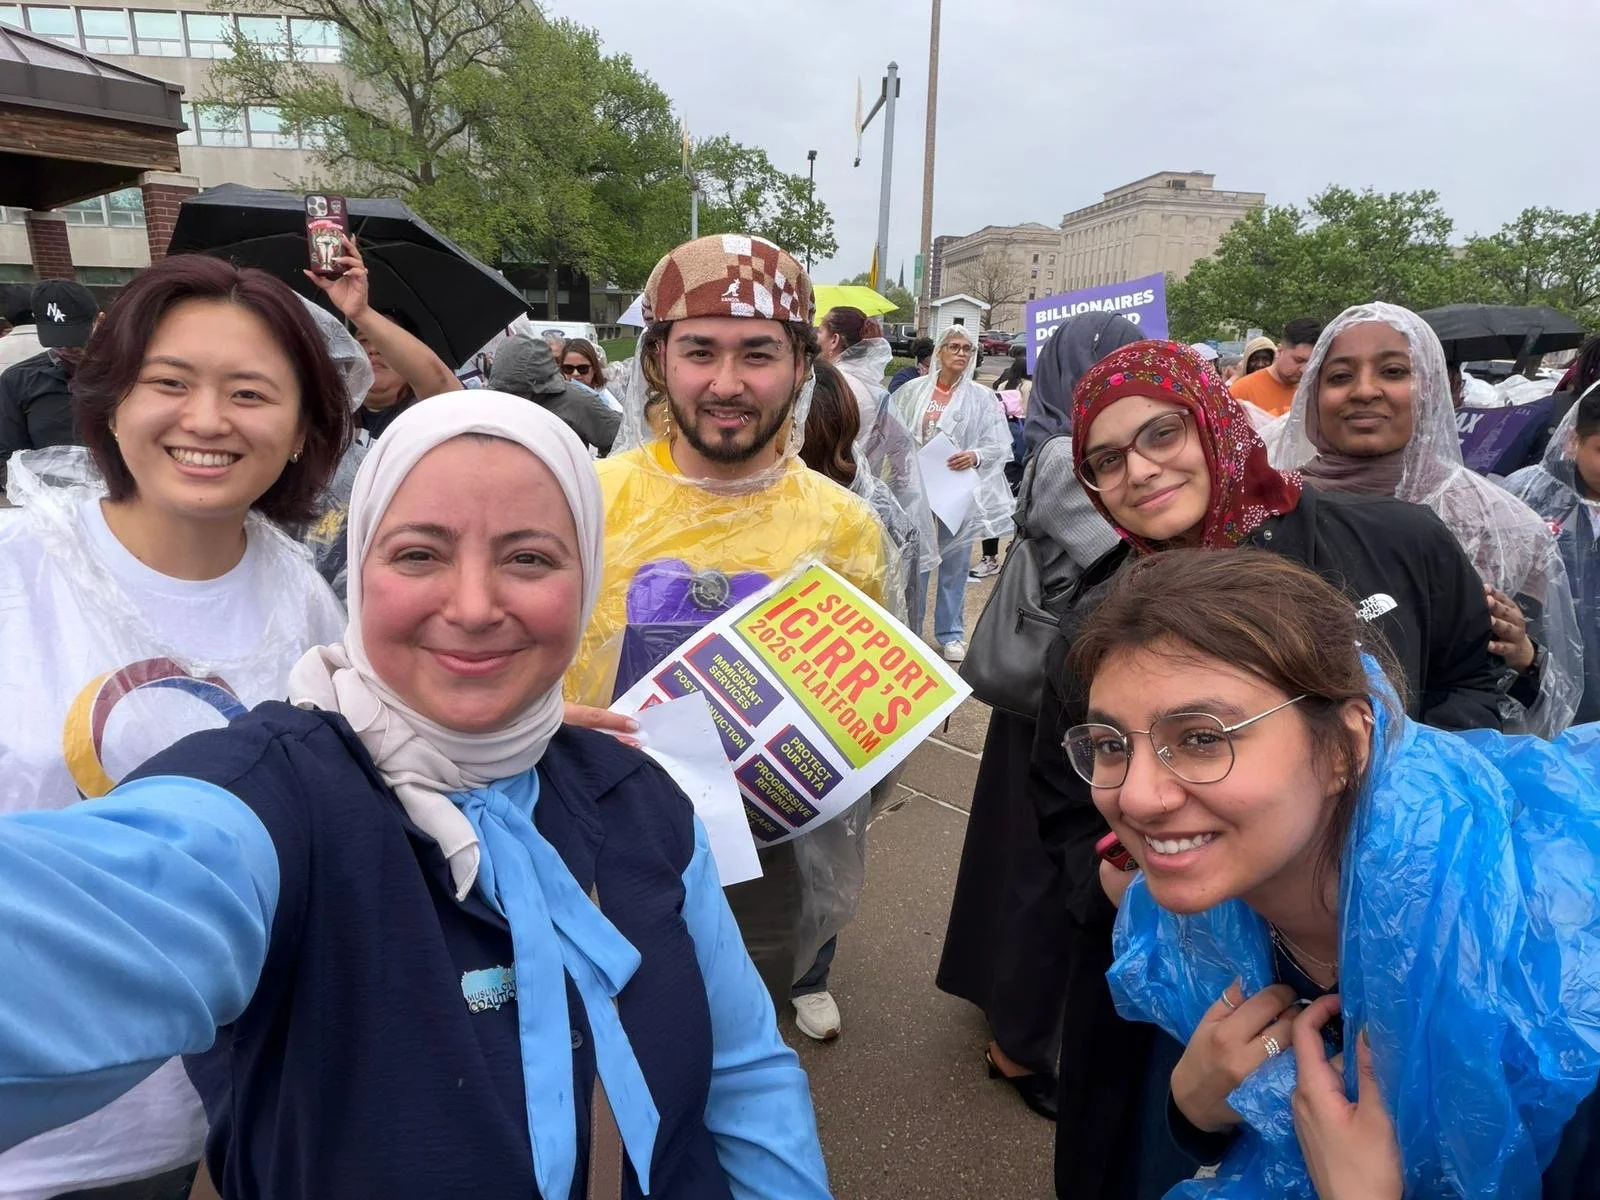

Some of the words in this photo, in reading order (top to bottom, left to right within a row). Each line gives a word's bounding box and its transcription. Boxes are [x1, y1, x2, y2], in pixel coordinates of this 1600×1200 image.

[1035, 289, 1155, 323] BILLIONAIRES
[1454, 412, 1485, 433] AX
[1360, 596, 1377, 609] THE
[799, 580, 821, 597] I
[817, 594, 939, 701] SUPPORT
[674, 669, 698, 693] POST
[709, 665, 751, 710] SERVICES
[713, 654, 764, 706] IMMIGRANT
[733, 660, 758, 686] FUND
[748, 619, 796, 662] 2026
[792, 660, 881, 753] PLATFORM
[764, 597, 912, 735] ICIRR'S
[781, 743, 801, 765] OUR
[799, 763, 825, 792] DATA
[790, 737, 832, 781] PROTECT
[755, 761, 813, 818] PROGRESSIVE
[755, 777, 796, 815] REVENUE
[471, 990, 516, 1012] COALITIO
